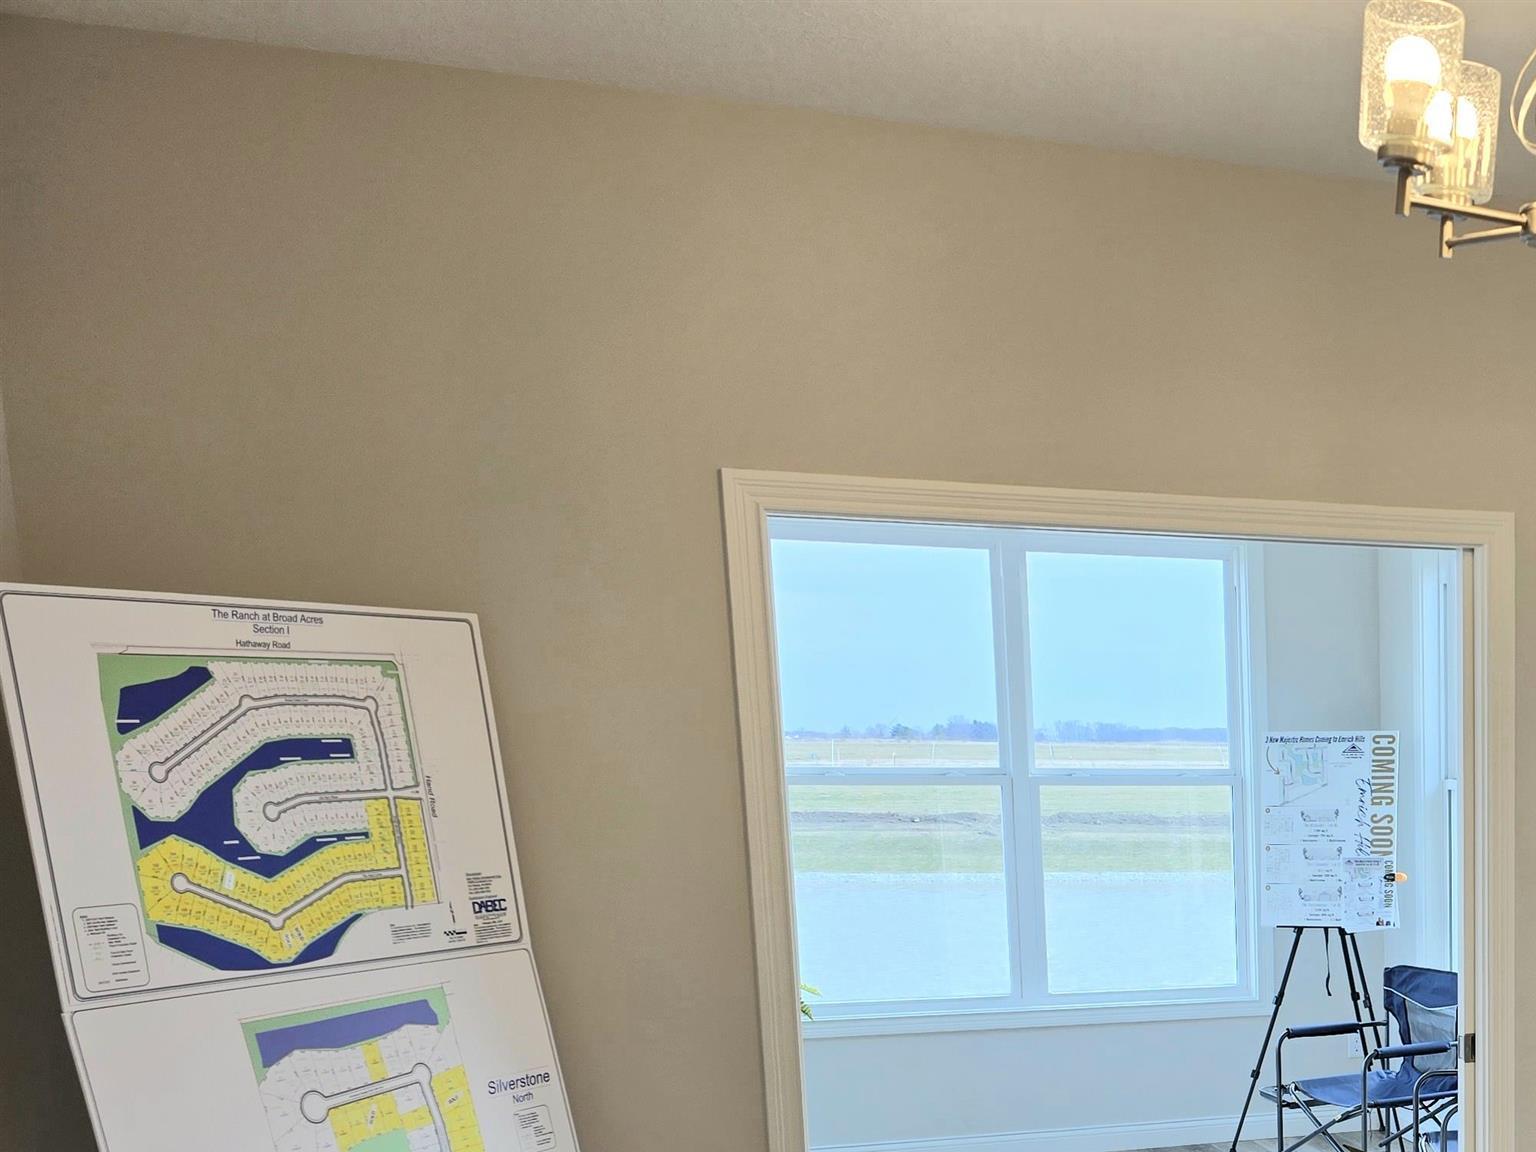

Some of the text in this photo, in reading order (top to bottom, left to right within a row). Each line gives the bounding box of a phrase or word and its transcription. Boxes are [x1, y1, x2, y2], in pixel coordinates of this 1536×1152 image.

[211, 608, 324, 624] The Ranch at Broad Acres
[252, 623, 285, 635] Section
[235, 639, 291, 650] Hathaway Road
[1370, 734, 1395, 806] COMING
[472, 898, 508, 915] DABEC
[1383, 889, 1394, 908] SOON
[487, 1071, 551, 1095] Silverstone
[512, 1091, 534, 1104] North
